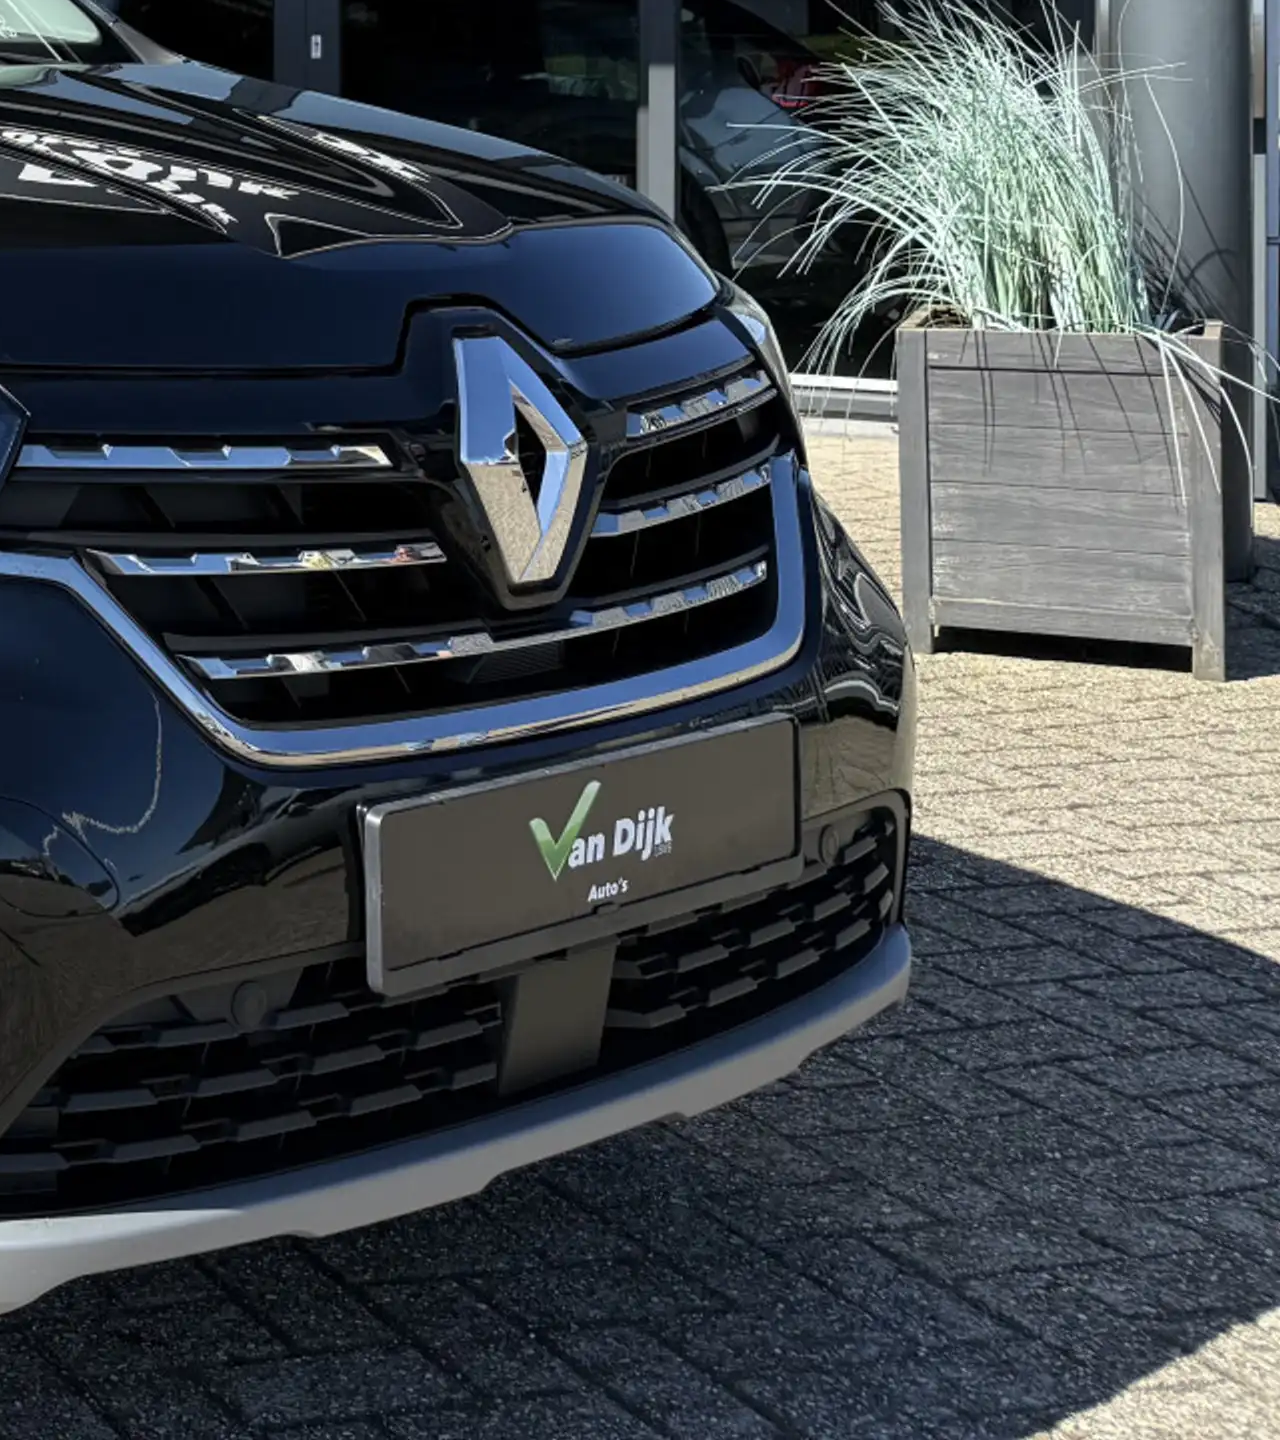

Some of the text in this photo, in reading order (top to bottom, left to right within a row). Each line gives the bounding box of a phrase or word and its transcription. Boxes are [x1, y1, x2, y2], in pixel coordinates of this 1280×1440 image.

[528, 779, 675, 882] Van Dijk
[587, 877, 629, 902] Auto's
